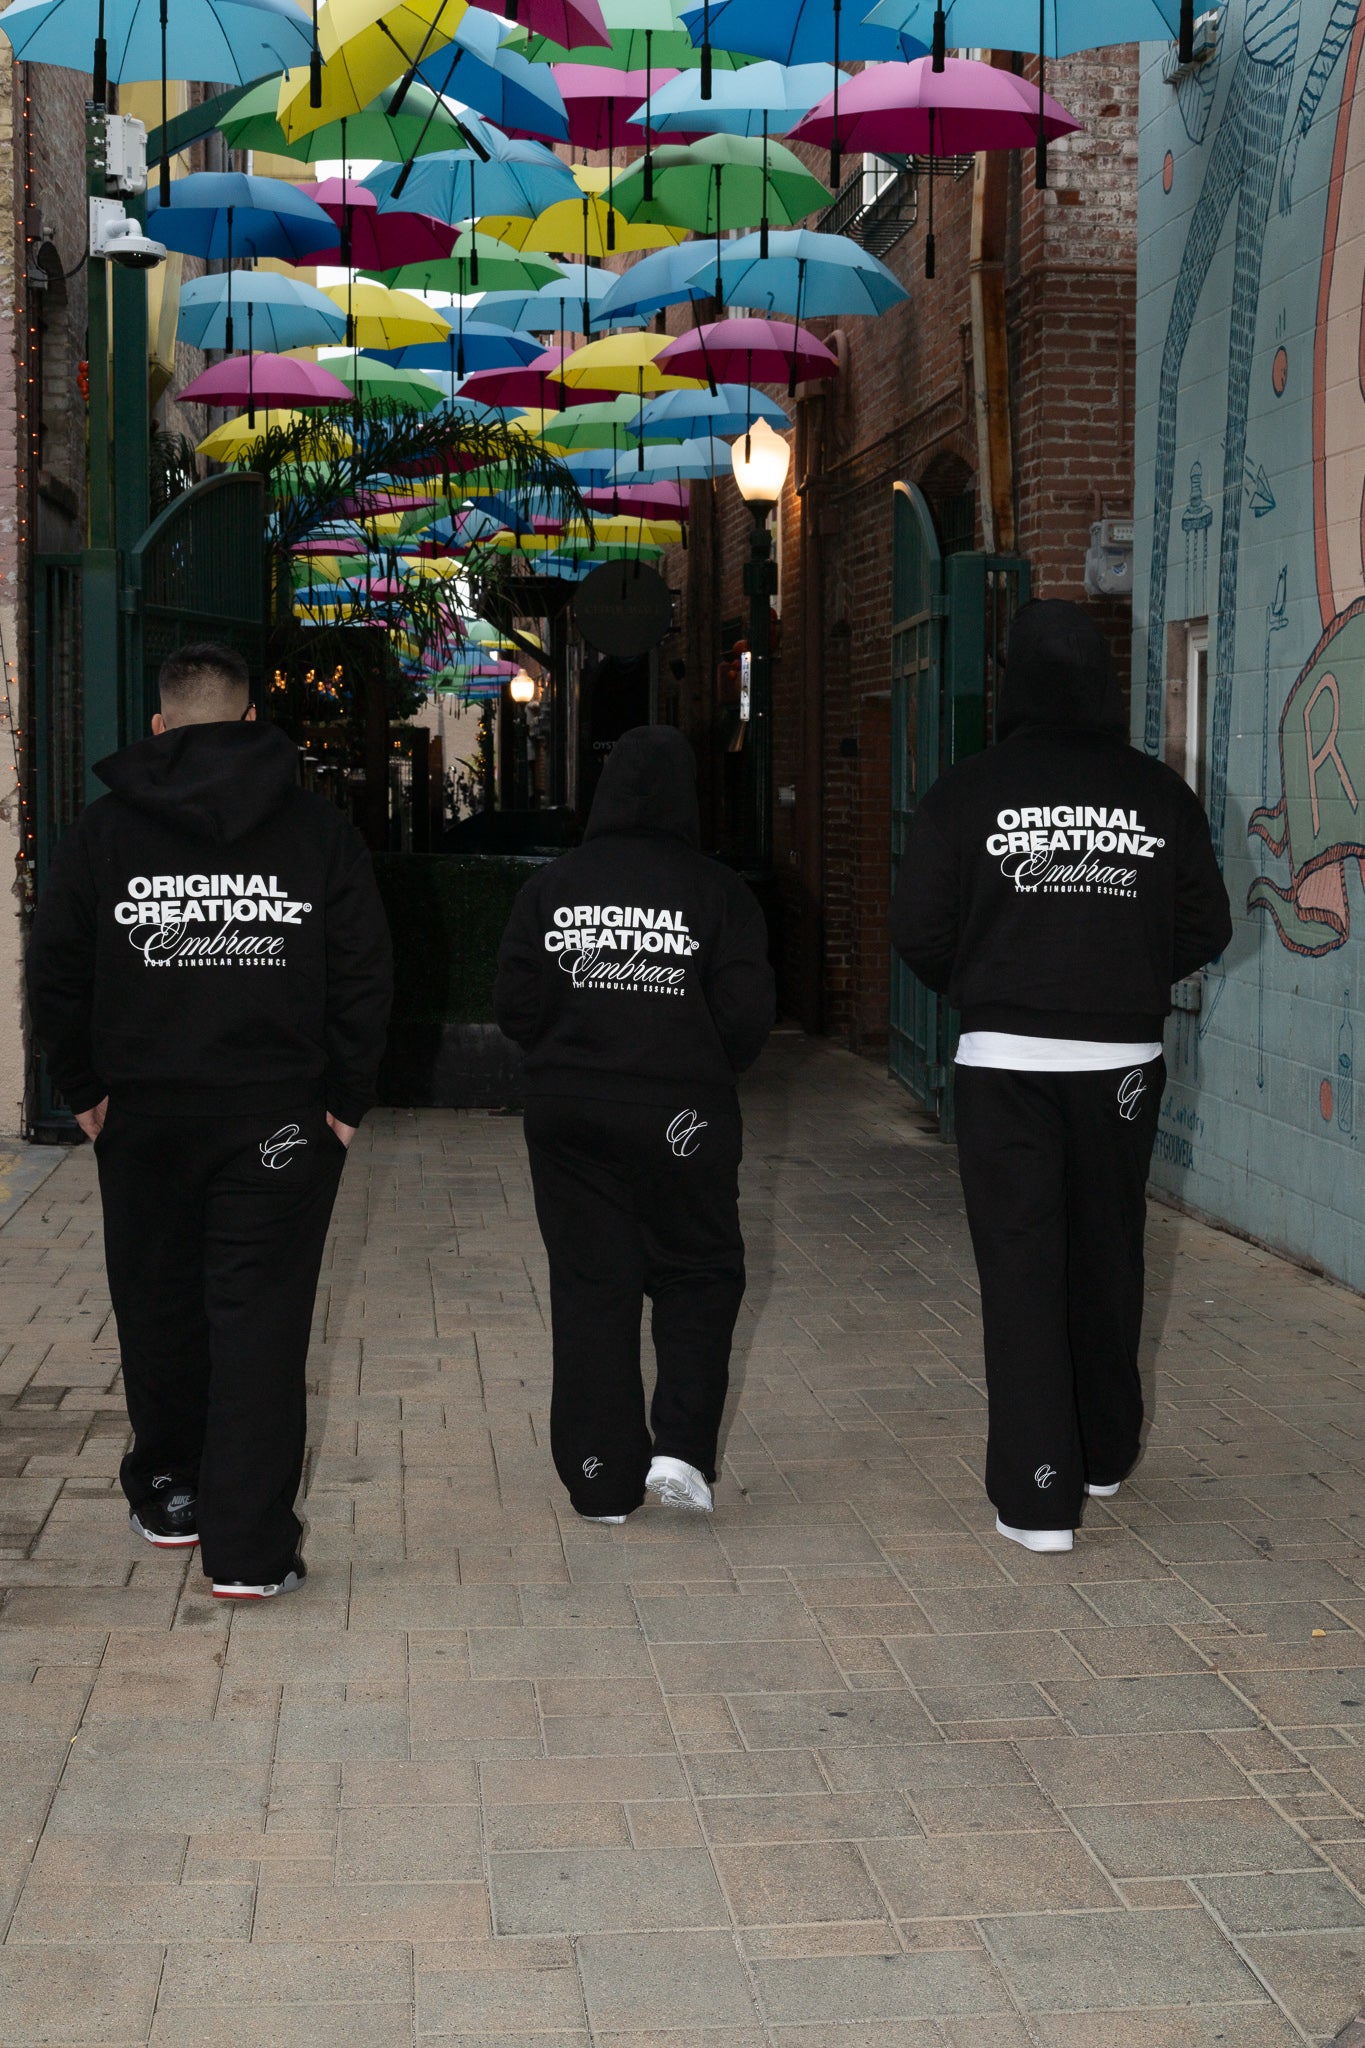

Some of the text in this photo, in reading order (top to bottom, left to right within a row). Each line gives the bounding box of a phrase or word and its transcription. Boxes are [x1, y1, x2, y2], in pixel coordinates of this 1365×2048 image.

[1303, 671, 1359, 839] R
[997, 805, 1146, 833] ORIGINAL
[1000, 838, 1137, 889] Embrace
[127, 874, 288, 899] ORIGINAL
[1043, 885, 1091, 893] SINGULAR
[1097, 886, 1138, 898] ESSENCE
[553, 905, 690, 933] ORIGINAL
[129, 907, 285, 964] Embrace
[178, 959, 232, 967] SINGULAR
[239, 958, 287, 967] ESSENCE
[558, 938, 686, 985] Embrace
[588, 981, 638, 991] SINGULAR
[643, 984, 685, 996] ESSENCE
[171, 1495, 191, 1505] NIKE
